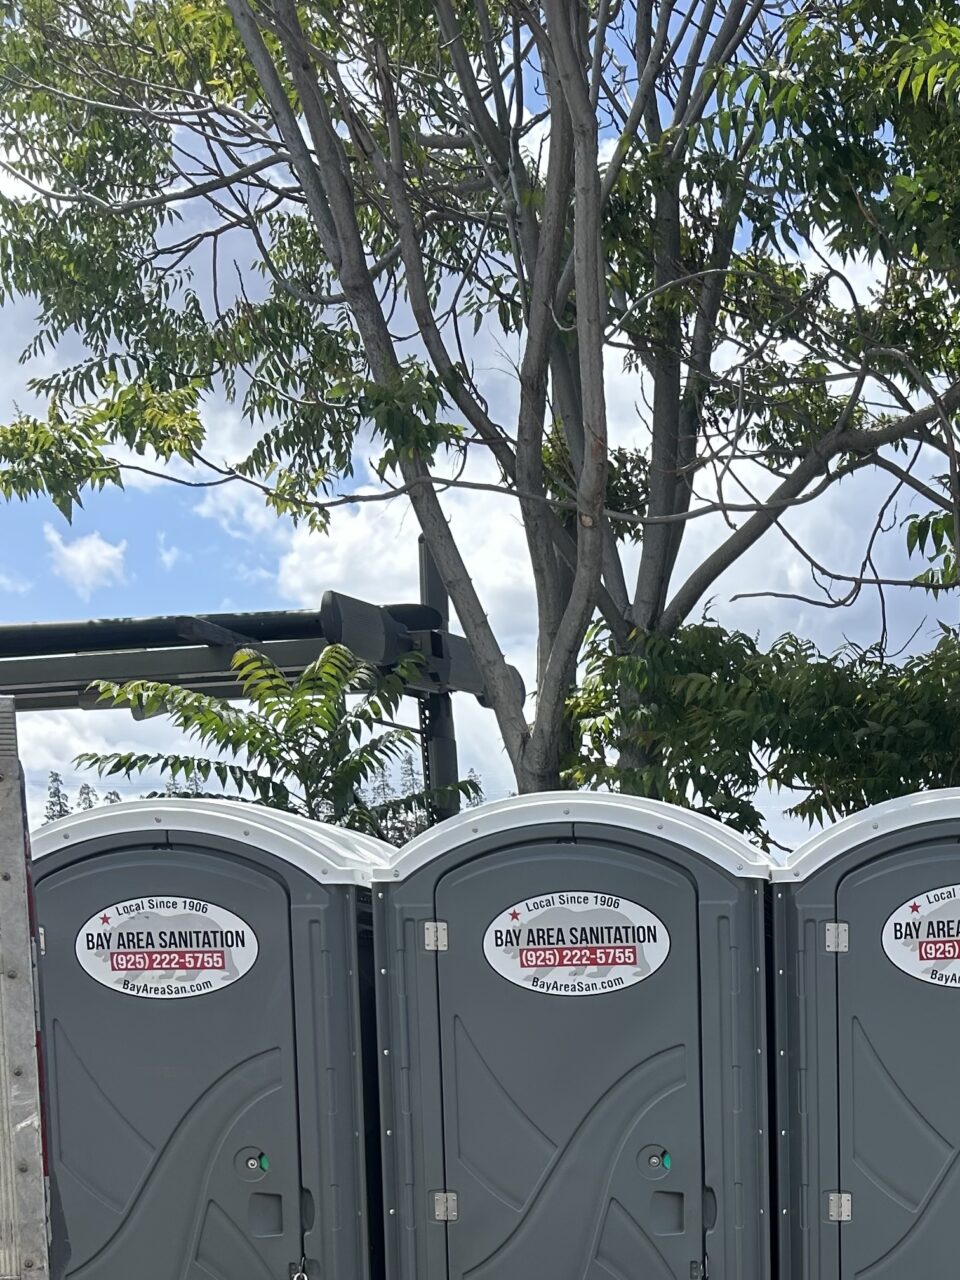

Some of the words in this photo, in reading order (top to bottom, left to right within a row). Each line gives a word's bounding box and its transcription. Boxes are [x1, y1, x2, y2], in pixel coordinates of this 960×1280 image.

[525, 896, 555, 912] Local
[558, 894, 589, 905] Since
[594, 895, 621, 909] 1906
[926, 888, 956, 904] Local
[116, 902, 145, 916] Local
[147, 899, 178, 909] Since
[182, 900, 208, 914] 1906
[494, 929, 522, 947] BAY
[526, 927, 565, 946] AREA
[569, 926, 657, 945] SANITATION
[894, 921, 922, 940] BAY
[86, 933, 112, 950] BAY
[117, 931, 155, 949] AREA
[159, 930, 246, 949] SANITATION
[522, 950, 559, 966] (925)
[563, 949, 634, 965] 222-5755
[921, 942, 958, 959] (925)
[113, 953, 149, 969] (925)
[153, 953, 223, 968] 222-5755
[122, 980, 213, 995] BayAreaSan.com
[532, 976, 624, 992] BayAreaSan.com
